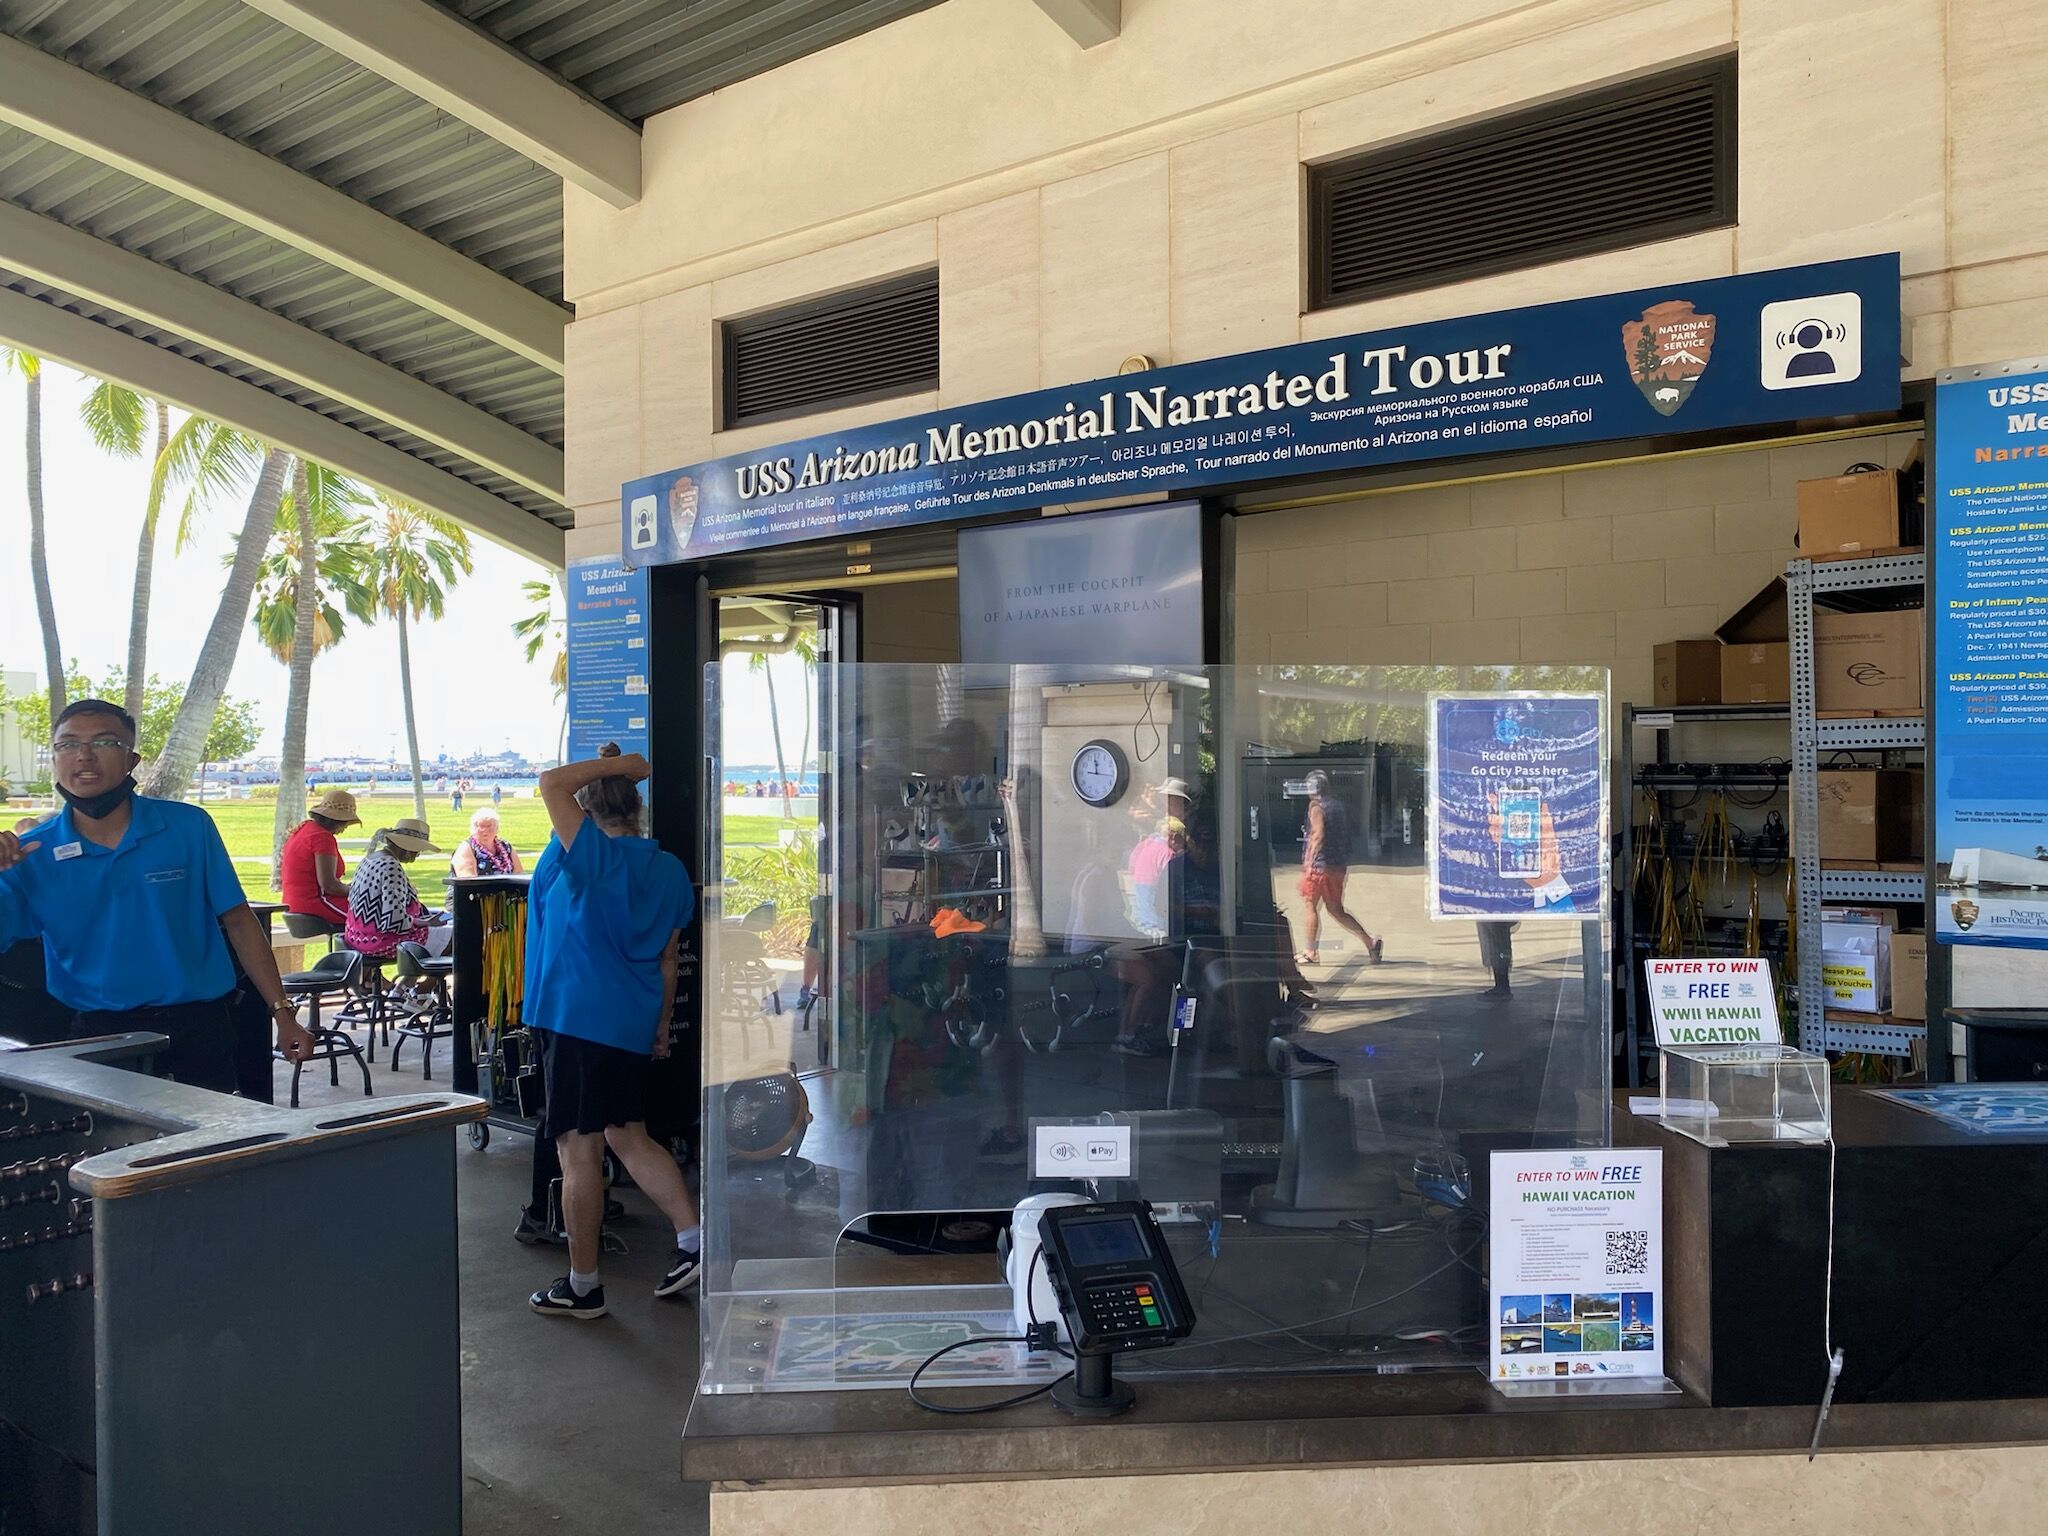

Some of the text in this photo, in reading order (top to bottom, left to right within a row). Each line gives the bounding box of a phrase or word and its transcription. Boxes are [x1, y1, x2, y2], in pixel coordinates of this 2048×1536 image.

[1658, 320, 1711, 335] NATIONAL
[1670, 331, 1698, 342] PARK
[1663, 338, 1706, 351] SERVICE
[1310, 373, 1604, 422] Экскурсия мемориального военного корабля США
[1374, 397, 1529, 427] Аризона на Русском языке
[735, 343, 1512, 500] USS Arizona Memorial Narrated Tour
[1111, 444, 1158, 463] 아리조나
[1212, 429, 1263, 447] 나레이션
[1265, 422, 1296, 440] 투어,
[760, 522, 770, 535] du
[837, 511, 846, 522] en
[848, 508, 873, 522] langue
[874, 501, 912, 518] française,
[914, 495, 951, 511] Geführte
[953, 492, 973, 505] Tour
[975, 489, 991, 502] des
[992, 484, 1026, 499] Arizona
[1028, 478, 1075, 494] Denkmals
[1077, 475, 1087, 487] in
[1088, 469, 1139, 486] deutscher
[1141, 462, 1189, 480] Sprache,
[1196, 458, 1222, 471] Tour
[1224, 451, 1270, 467] narrado
[1272, 447, 1291, 460] del
[1295, 438, 1369, 458] Monumento
[1372, 435, 1384, 447] al
[1388, 428, 1438, 445] Arizona
[1442, 427, 1460, 439] en
[1464, 422, 1476, 436] el
[1480, 417, 1528, 434] idioma
[1533, 408, 1593, 430] español
[1950, 483, 2015, 497] USS Arizona
[1984, 496, 2013, 505] Official
[702, 495, 835, 528] USS Arizona Memorial tour in italiano
[1966, 505, 2035, 517] Hosted by Jamie
[1950, 524, 2016, 536] USS Arizona
[1950, 535, 2027, 548] Regularly priced at
[1967, 545, 2045, 557] Use of smartphone
[1984, 558, 2002, 566] USS
[2003, 557, 2036, 565] Arizona
[581, 569, 599, 581] USS
[1967, 568, 2018, 578] Smartphone
[586, 580, 627, 596] Memorial
[1006, 575, 1145, 599] FROM THE COCKPIT
[1967, 580, 2010, 589] Admission
[2021, 578, 2036, 586] the
[1950, 597, 2023, 610] Day of Infamy
[984, 598, 1172, 623] OF A JAPANESE WARPLANE
[1950, 608, 2027, 620] Regularly priced at
[1984, 620, 2002, 629] USS
[2003, 619, 2036, 627] Arizona
[1974, 632, 1997, 640] Pearl
[1997, 631, 2027, 639] Harbor
[2028, 630, 2048, 638] Tote
[1967, 643, 1986, 651] Dec.
[1997, 642, 2018, 651] 1941
[1950, 673, 2016, 681] USS Arizona
[1481, 751, 1558, 763] Redeem your
[1471, 765, 1569, 778] Go City Pass here
[2010, 909, 2045, 919] PACIFIC
[1991, 915, 2036, 926] HISTORIC
[1654, 962, 1759, 974] ENTER TO WIN
[1846, 968, 1866, 976] Place
[1838, 979, 1873, 989] Vouchers
[1688, 983, 1730, 999] FREE
[1835, 991, 1853, 999] Here
[1662, 1007, 1762, 1021] WWII HAWAII
[1669, 1027, 1761, 1043] VACATION
[1098, 1147, 1114, 1157] Pay
[1516, 1166, 1642, 1183] ENTER TO WIN FREE
[1522, 1190, 1636, 1203] HAWAII VACATION
